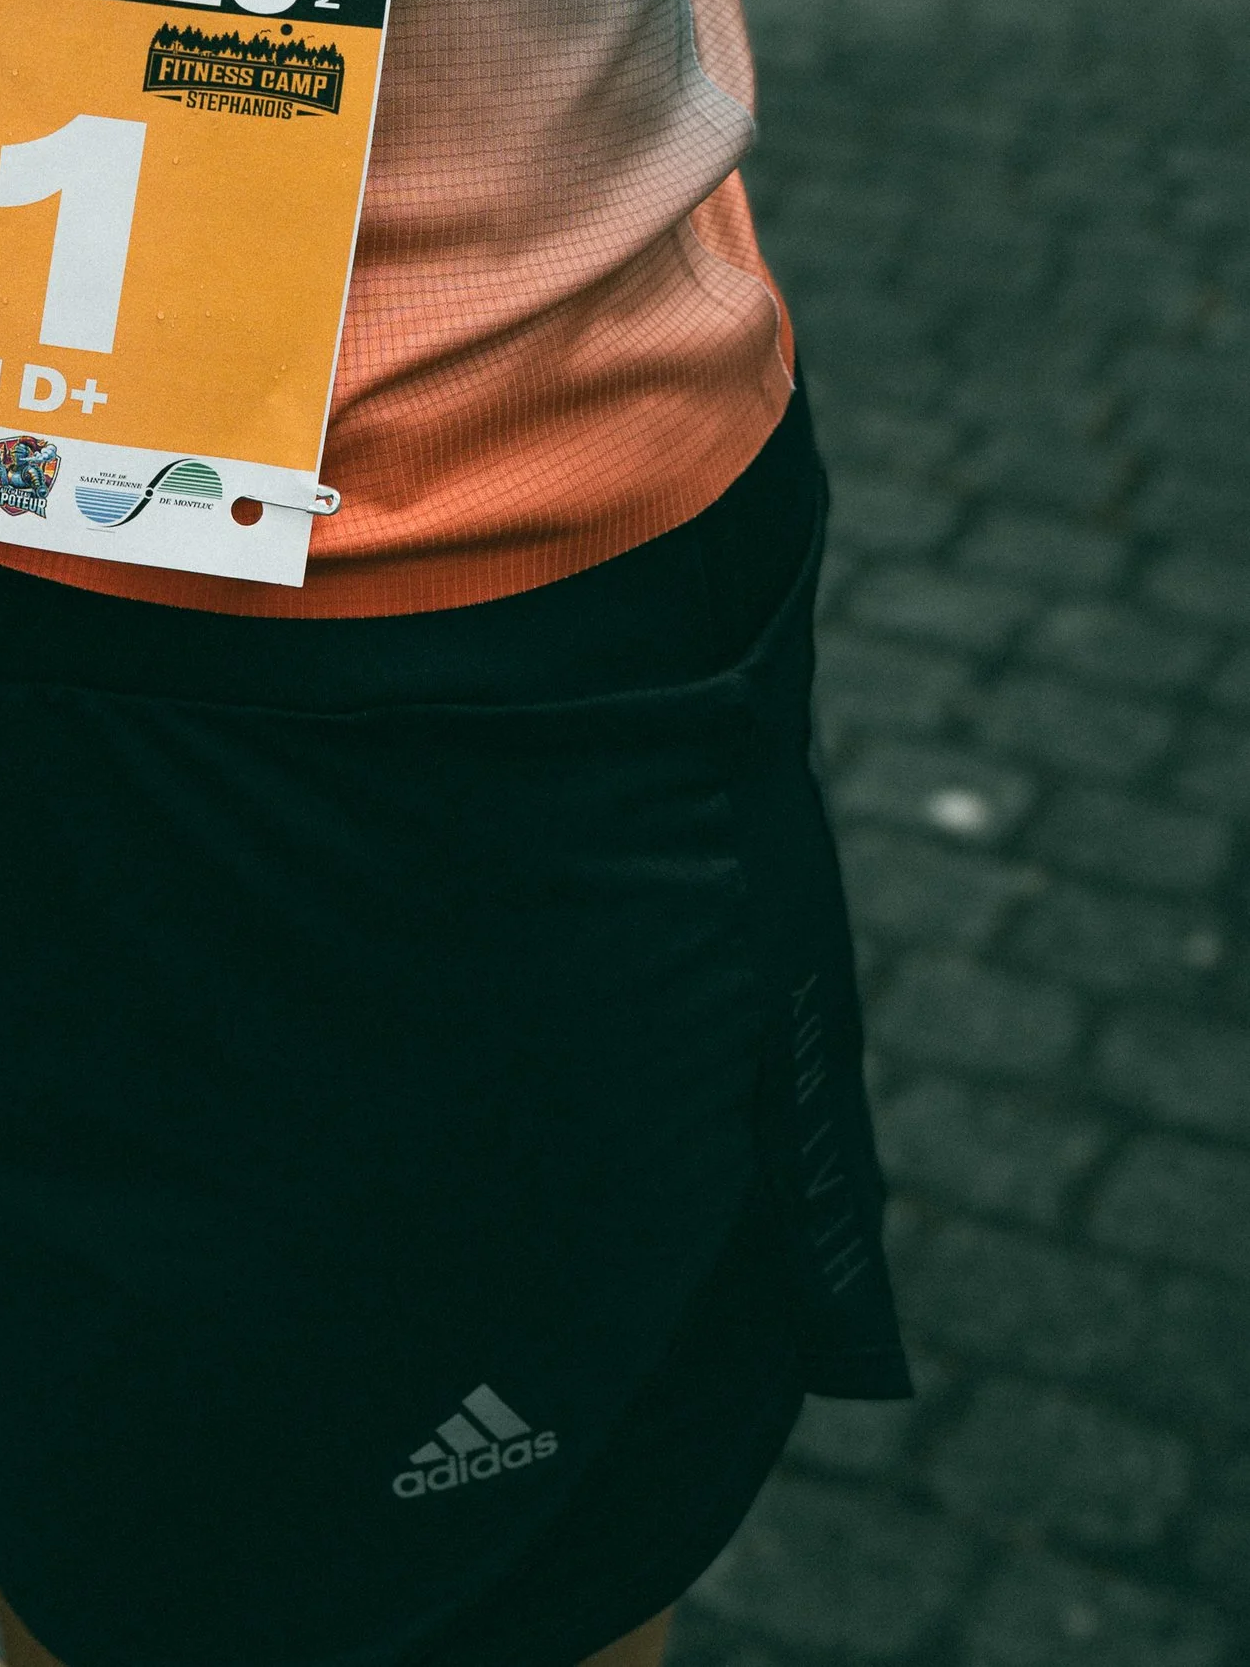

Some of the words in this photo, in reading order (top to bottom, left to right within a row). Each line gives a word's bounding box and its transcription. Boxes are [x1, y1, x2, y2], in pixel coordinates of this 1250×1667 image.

[157, 59, 254, 87] FITNESS
[260, 70, 329, 99] CAMP
[185, 90, 294, 120] STEPHANOIS
[18, 364, 109, 414] D+
[79, 475, 105, 486] SAINT
[158, 496, 172, 506] DE
[173, 498, 215, 511] MONTLUC
[392, 1430, 559, 1498] adidas
